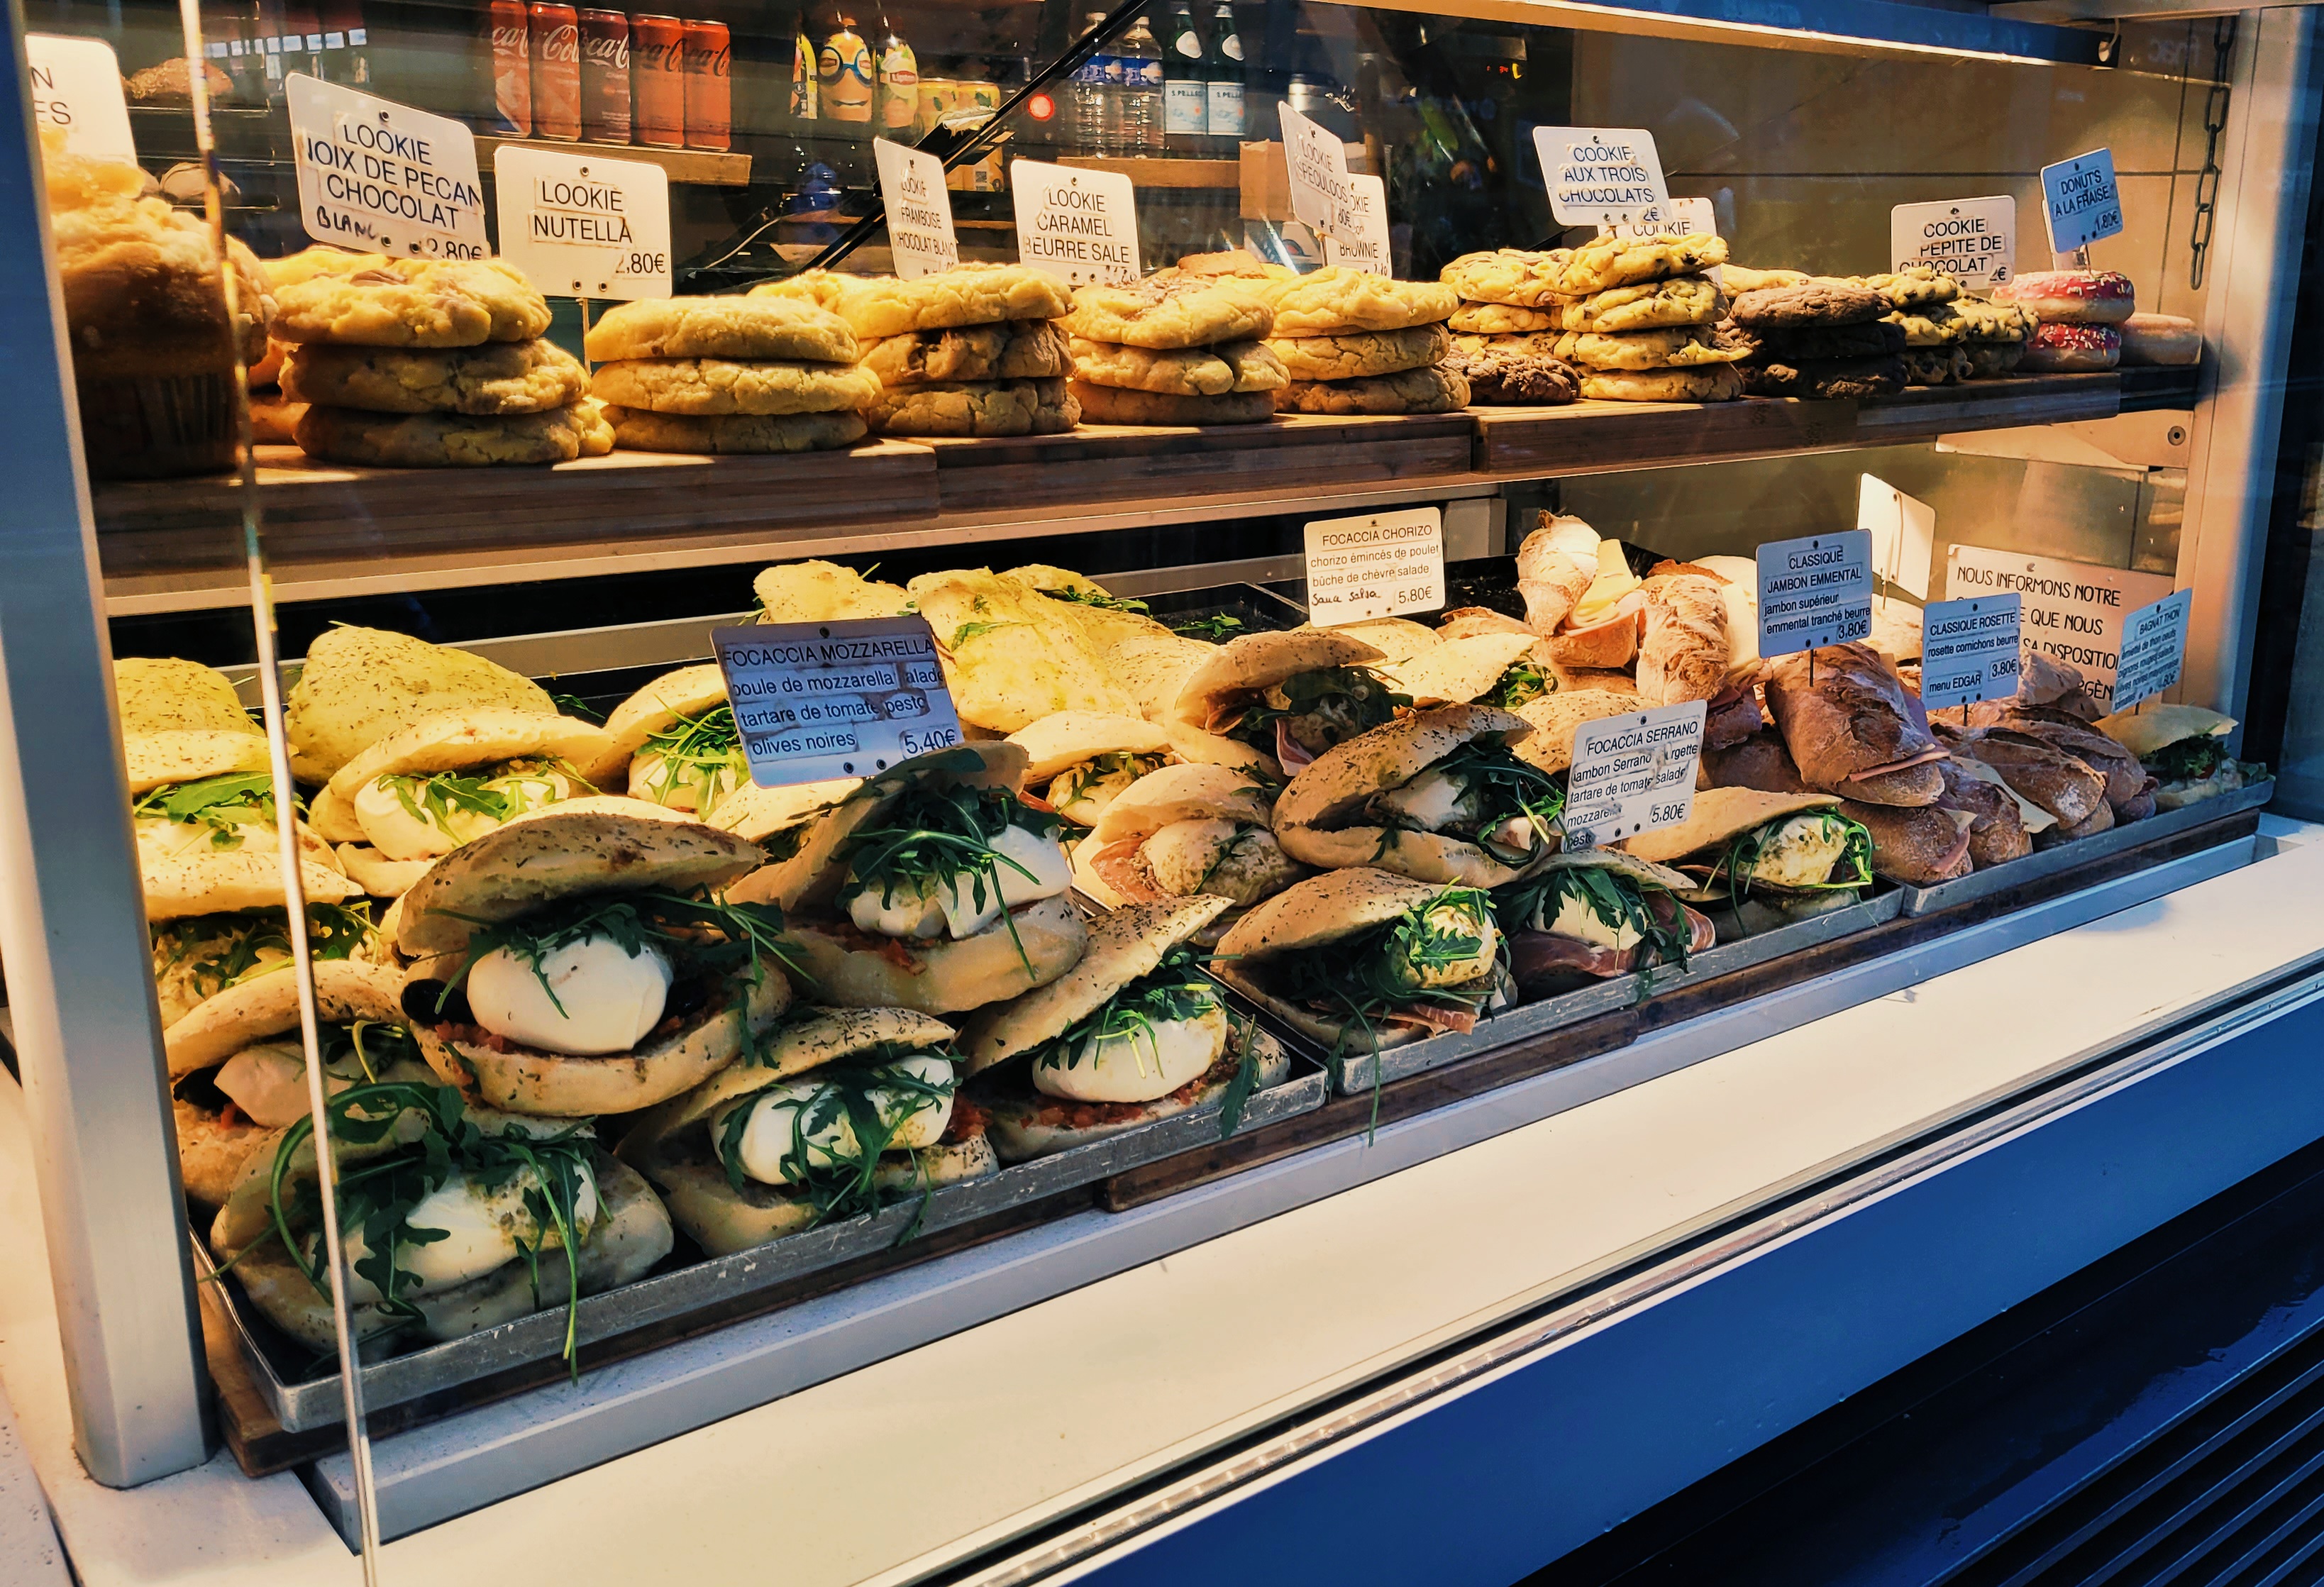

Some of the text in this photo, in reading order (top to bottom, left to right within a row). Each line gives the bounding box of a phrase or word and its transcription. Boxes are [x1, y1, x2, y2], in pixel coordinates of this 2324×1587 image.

[344, 124, 432, 166] LOOKIE
[1573, 145, 1632, 162] COOKIE
[364, 154, 398, 186] DE
[1564, 167, 1647, 182] AUX TROIS
[327, 174, 458, 230] CHOCOLAT
[542, 180, 624, 212] LOOKIE
[1048, 188, 1106, 213] LOOKIE
[1559, 187, 1654, 203] CHOCOLATS
[2062, 199, 2076, 214] LA
[2076, 185, 2110, 210] FRAISE
[533, 215, 633, 243] NUTELLA
[900, 206, 942, 229] FRAMBOISE
[1037, 214, 1113, 237] CARAMEL
[1923, 218, 1986, 238] COOKIE
[1091, 243, 1130, 263] SALE
[1920, 235, 2003, 258] PEPITE DE
[1322, 524, 1432, 546] FOCACCIA CHORIZO
[1310, 544, 1439, 568] chorizo émincés de poulet
[1788, 549, 1844, 570] CLASSIQUE
[1312, 564, 1429, 587] bûche de chèvre salade
[1767, 567, 1862, 594] JAMBON EMMENTAL
[1957, 566, 2121, 607] NOUS INFORMONS NOTRE
[1764, 593, 1839, 617] jambon supérieur
[1766, 606, 1871, 634] emmental tranché beurre
[1930, 618, 1978, 636] CLASSIQUE
[1979, 612, 2015, 629] ROSETTE
[2030, 608, 2060, 629] QUE
[2064, 614, 2104, 636] NOUS
[820, 638, 936, 662] MOZZARELLA
[1927, 634, 2019, 658] rosette cornichons beurre
[782, 676, 804, 692] de
[807, 670, 895, 691] mozzarella
[906, 667, 944, 684] alade
[1929, 674, 1981, 692] menu EDGAR
[740, 709, 796, 728] tartare
[800, 704, 821, 721] de
[751, 730, 856, 756] olives noires
[904, 728, 956, 754] 5,40€
[1587, 720, 1698, 756] FOCACCIA SERRANO
[1612, 753, 1651, 772] Serrano
[1570, 787, 1603, 803] tartare
[1605, 783, 1617, 796] de
